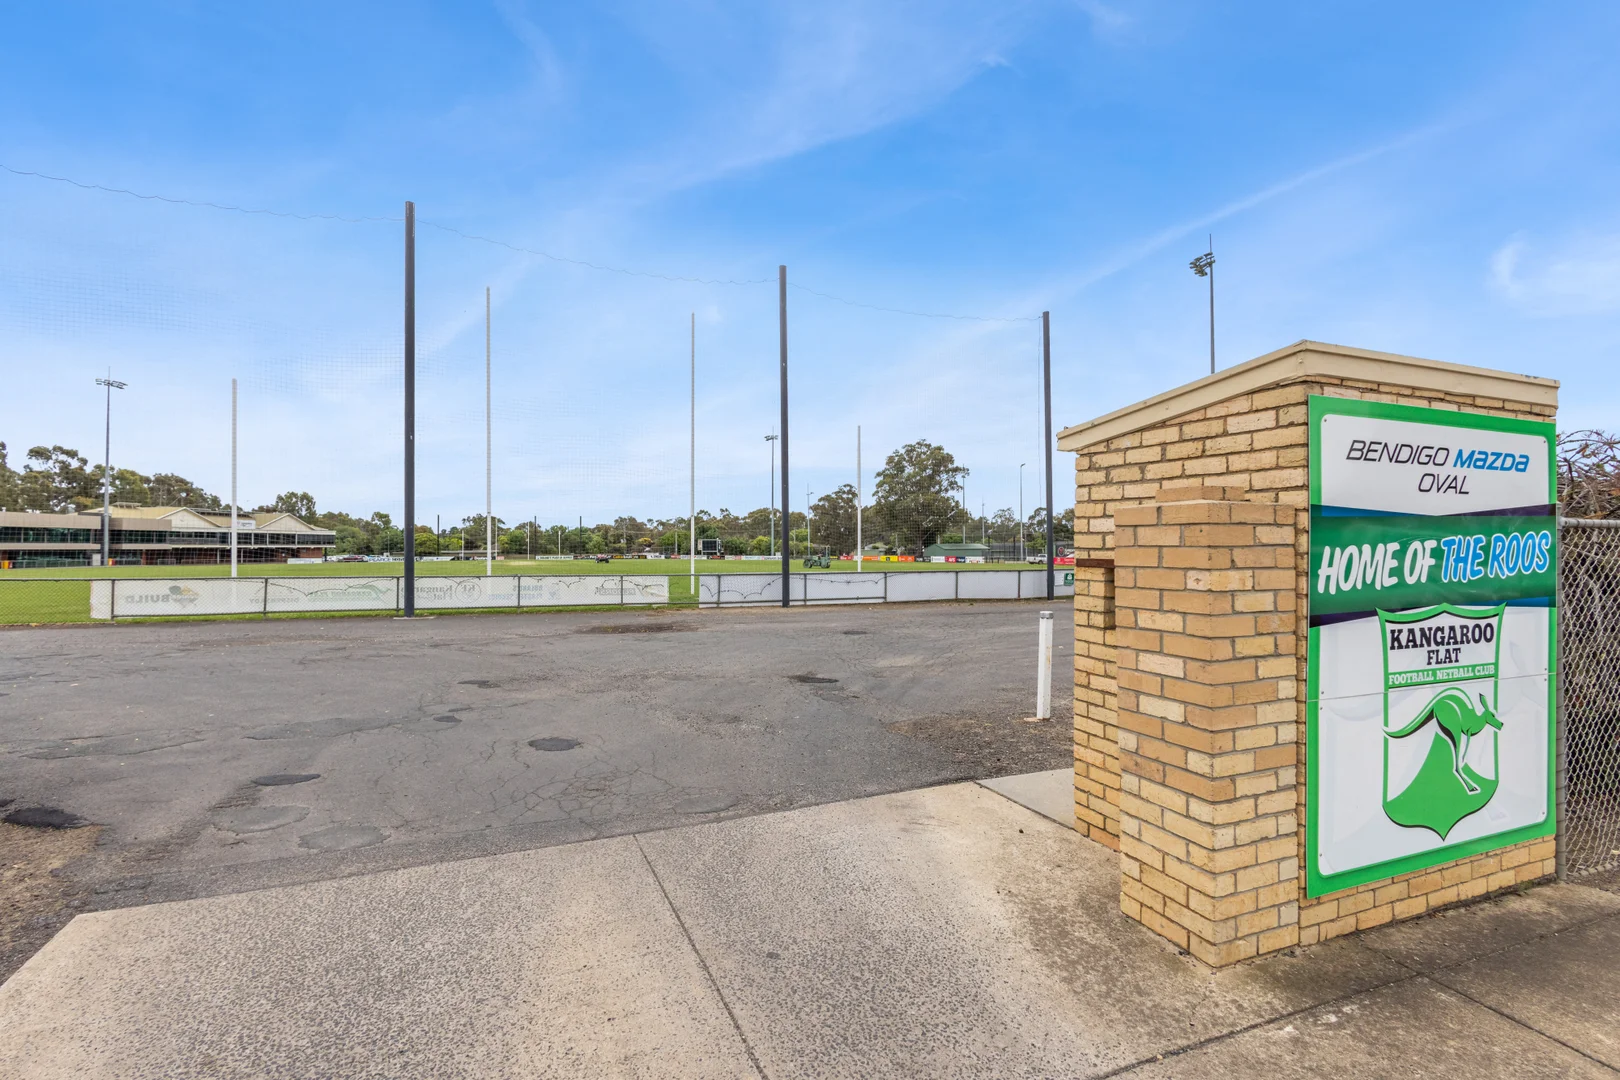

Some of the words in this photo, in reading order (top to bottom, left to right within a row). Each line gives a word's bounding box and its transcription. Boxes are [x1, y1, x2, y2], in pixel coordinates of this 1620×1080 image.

[1346, 439, 1450, 467] BENDIGO
[1418, 473, 1470, 495] OVAL
[1317, 542, 1401, 595] HOME
[1403, 539, 1438, 585] OF
[1441, 535, 1485, 583] THE
[1488, 530, 1552, 579] ROOS
[1389, 622, 1495, 651] KANGAROO
[1426, 648, 1461, 666] FLAT
[1388, 671, 1434, 685] FOOTBALL
[1436, 667, 1474, 680] NETBALL
[1474, 665, 1495, 676] CLUB
